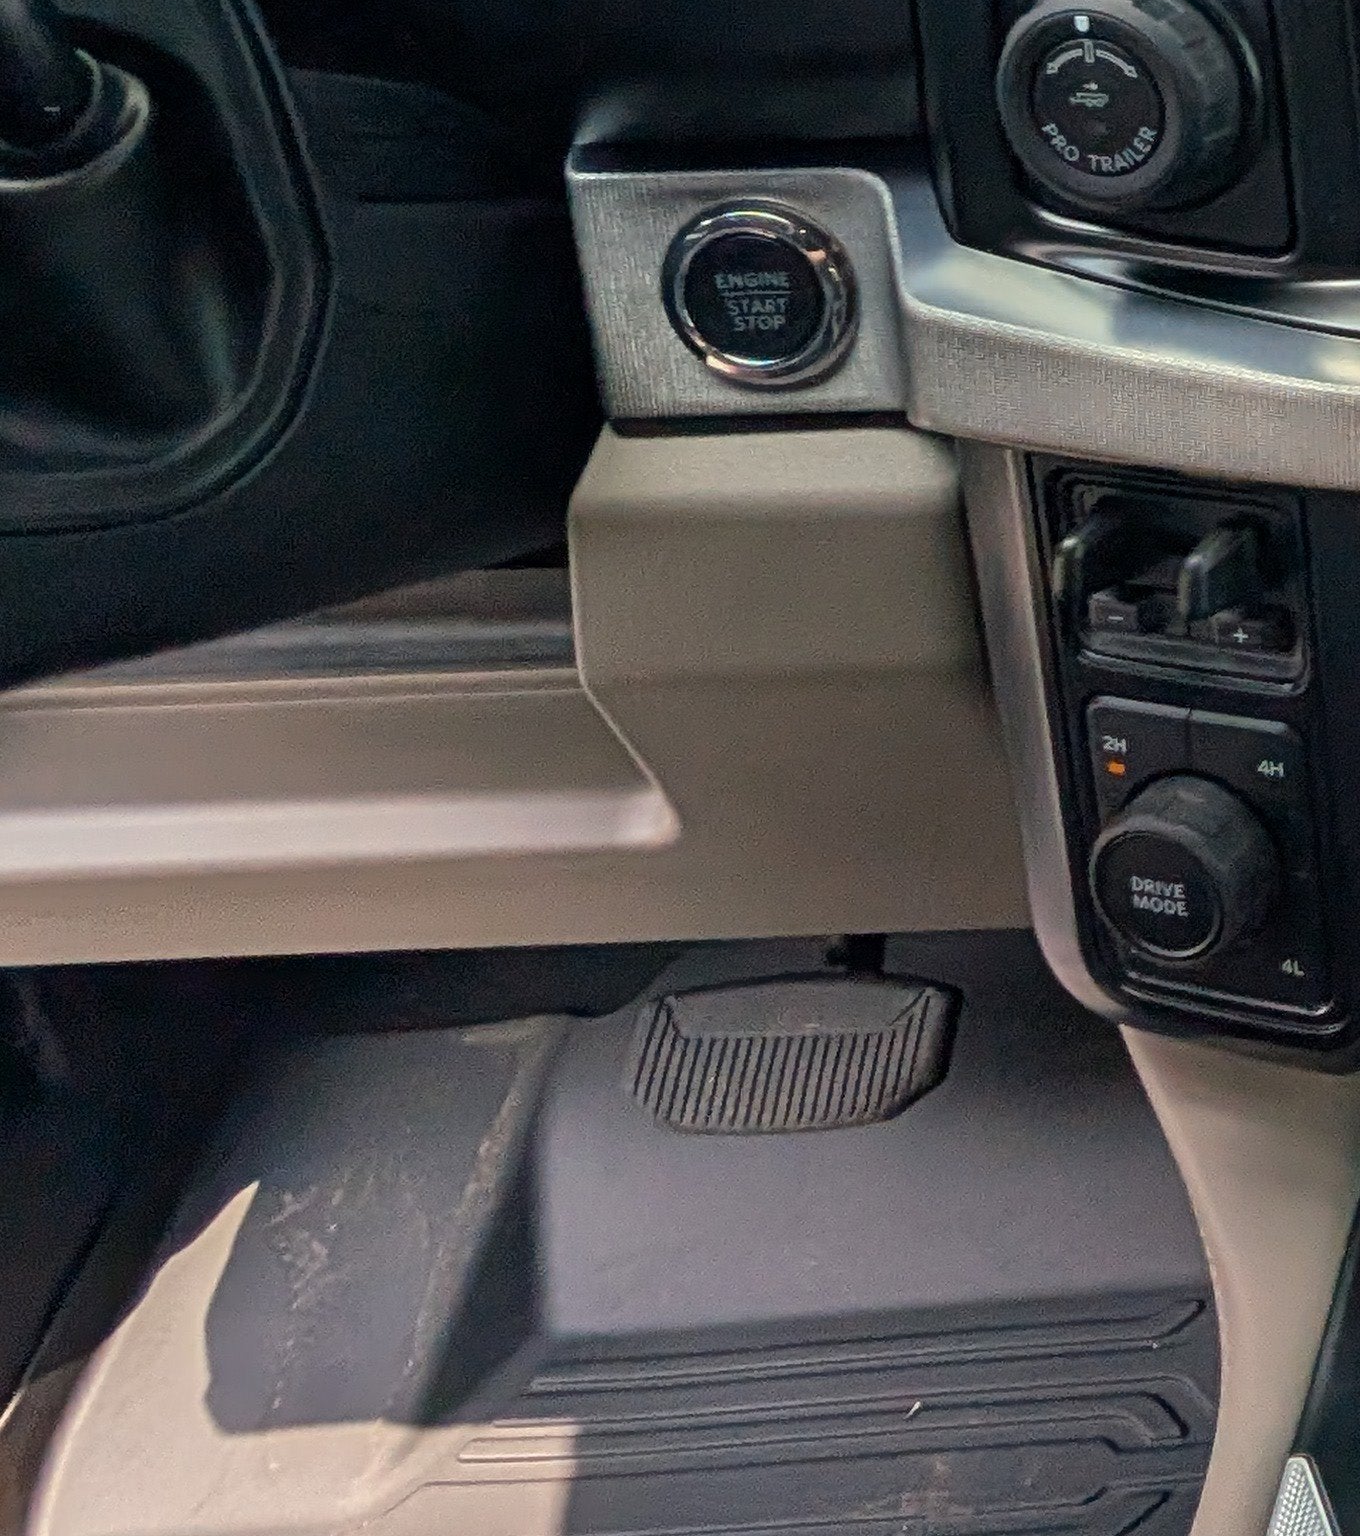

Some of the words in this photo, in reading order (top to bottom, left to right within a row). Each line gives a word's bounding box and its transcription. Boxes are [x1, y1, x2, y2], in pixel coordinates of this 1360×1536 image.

[1041, 121, 1081, 163] PRO
[1087, 125, 1159, 173] TRAILER
[715, 271, 790, 289] ENGINE
[723, 298, 788, 315] START
[732, 315, 787, 332] STOP
[1101, 734, 1128, 755] 2H
[1256, 758, 1286, 778] 4H
[1130, 875, 1186, 900] DRIVE
[1132, 894, 1189, 917] MODE
[1280, 957, 1304, 977] 4L
